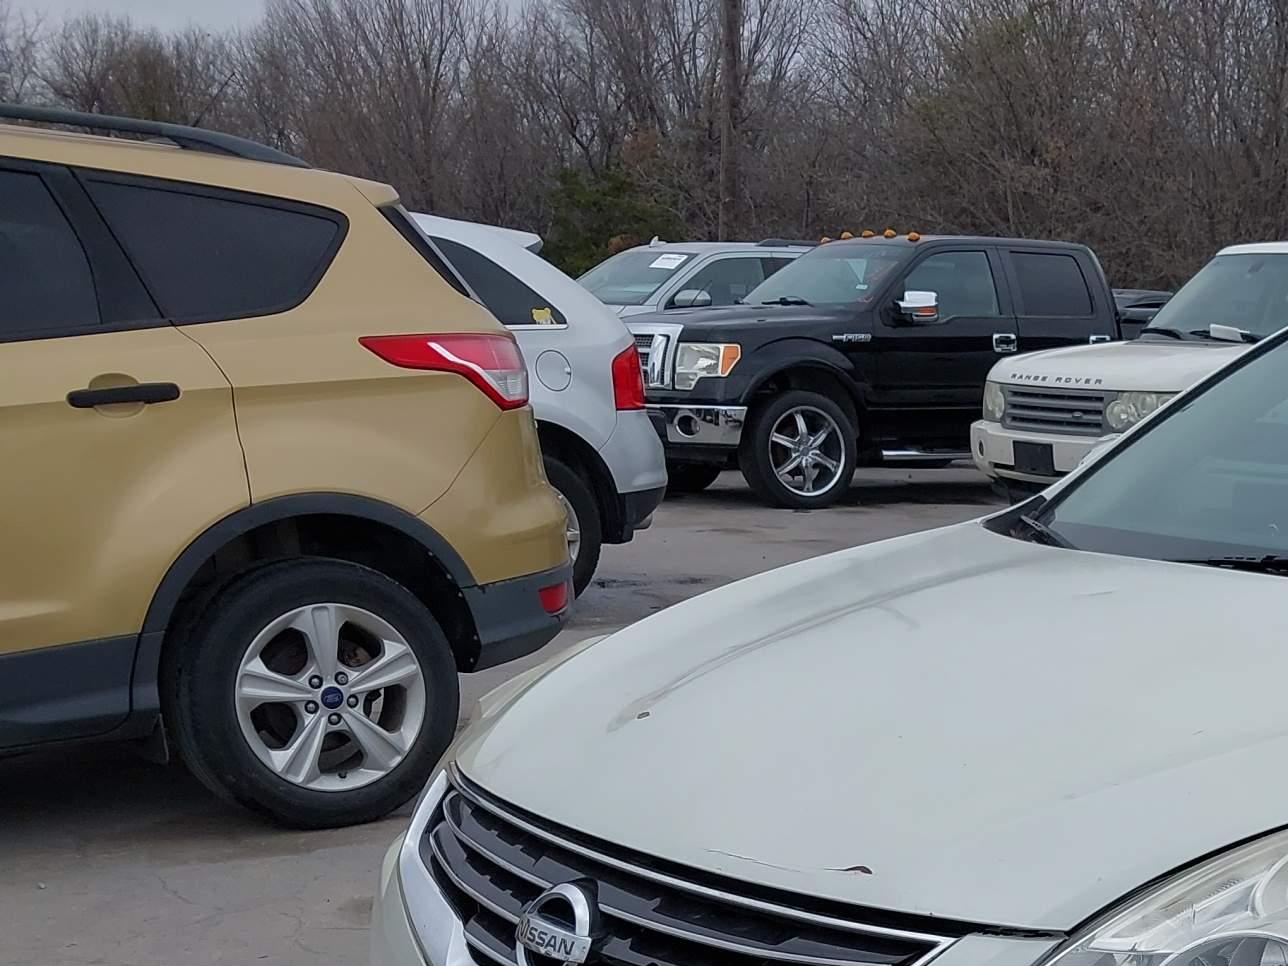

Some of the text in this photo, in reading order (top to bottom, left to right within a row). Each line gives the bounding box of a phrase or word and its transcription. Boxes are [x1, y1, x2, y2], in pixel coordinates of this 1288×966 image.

[1011, 373, 1103, 385] RANGE ROVER
[518, 918, 576, 956] NISSAN
